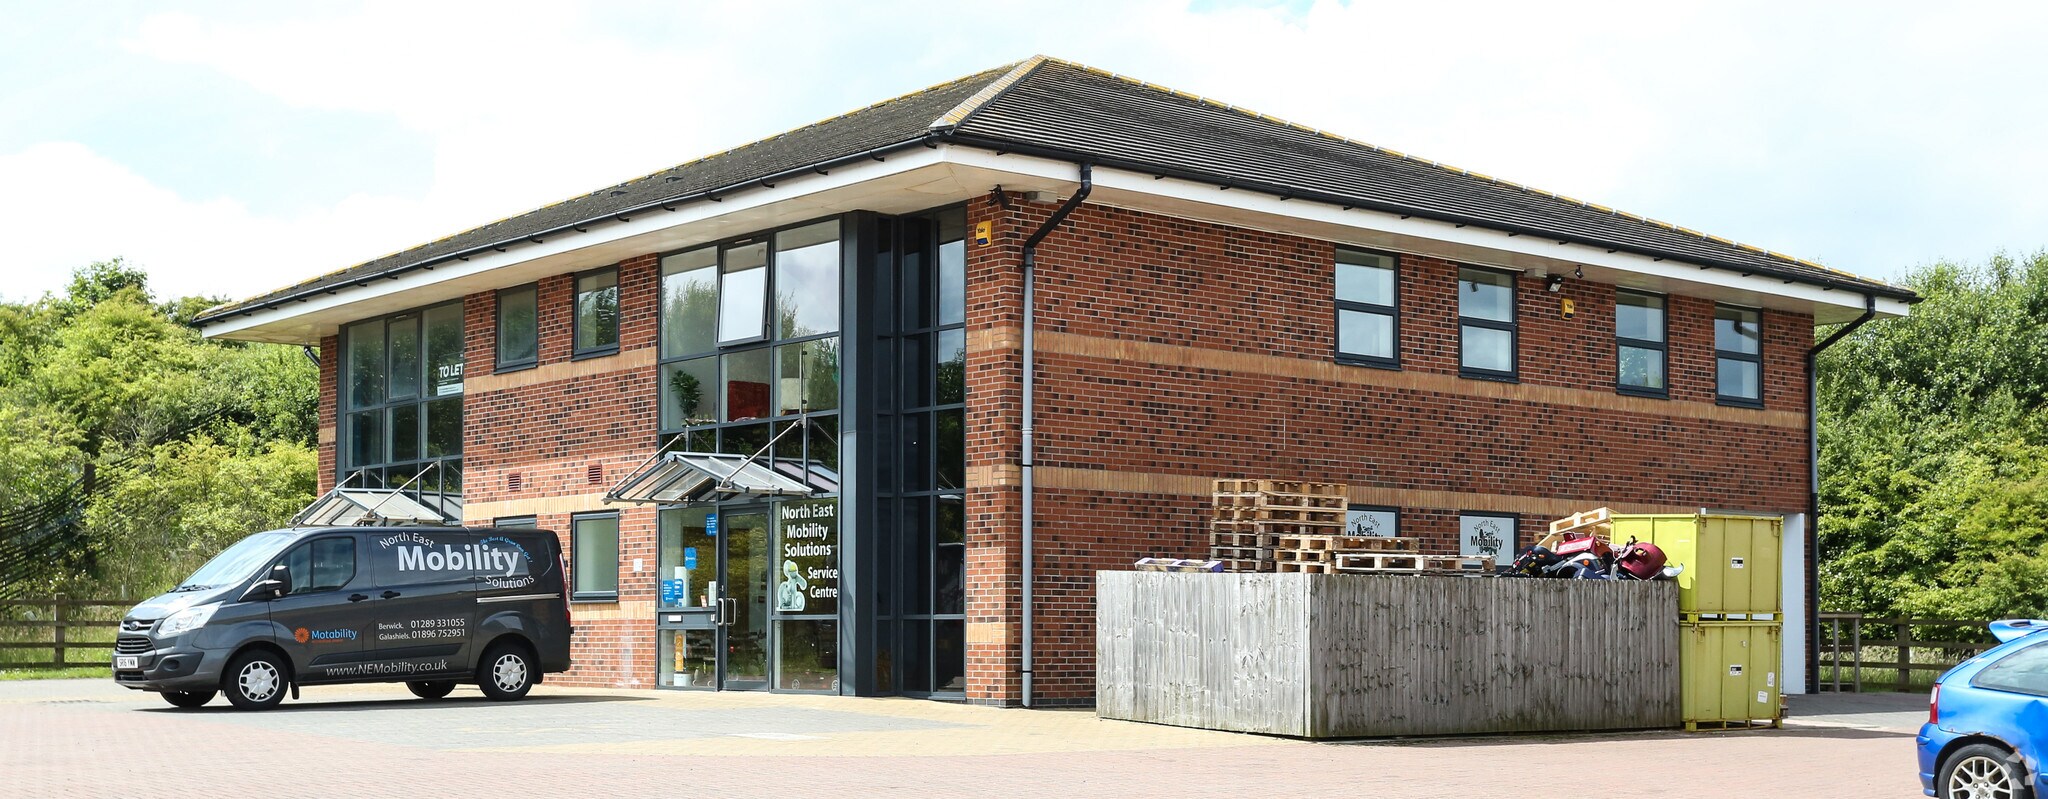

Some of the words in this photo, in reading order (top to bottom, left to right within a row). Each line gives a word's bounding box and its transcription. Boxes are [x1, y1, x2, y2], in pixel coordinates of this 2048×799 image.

[439, 365, 449, 378] TO
[450, 363, 463, 376] LET
[782, 503, 810, 519] North
[812, 503, 834, 517] East
[1351, 513, 1368, 527] North
[1368, 514, 1381, 528] East
[1474, 519, 1489, 532] North
[1490, 520, 1500, 533] East
[786, 522, 829, 541] Mobility
[379, 532, 410, 549] North
[412, 532, 435, 548] East
[1470, 535, 1503, 550] Mobility
[784, 542, 832, 557] Solutions
[397, 544, 519, 577] Mobility
[807, 565, 838, 579] Service
[485, 575, 535, 589] Solutions
[810, 585, 838, 598] Centre
[410, 619, 435, 628] 01289
[437, 618, 465, 627] 331055
[311, 628, 357, 640] Motability
[411, 630, 436, 639] 01896
[437, 628, 465, 637] 752951
[326, 659, 448, 676] www.NEMobility.co.uk
